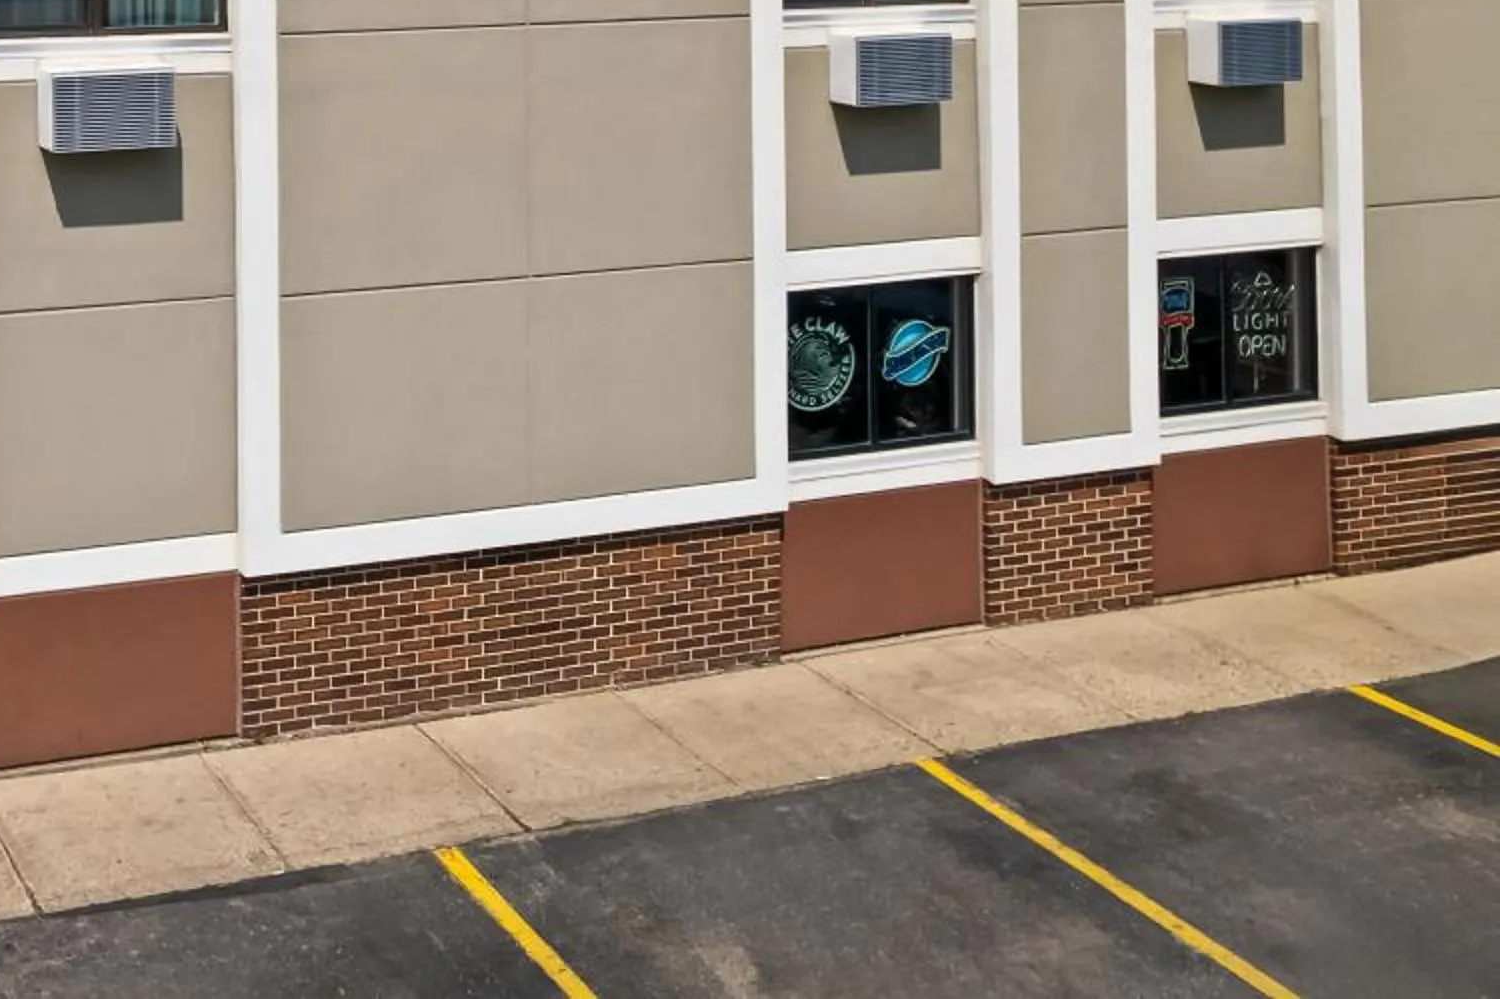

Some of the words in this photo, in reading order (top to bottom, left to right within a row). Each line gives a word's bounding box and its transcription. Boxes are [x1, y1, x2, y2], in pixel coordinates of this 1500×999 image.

[805, 316, 850, 345] CLAW
[1233, 310, 1291, 332] LIGHT
[1238, 333, 1286, 357] OPEN
